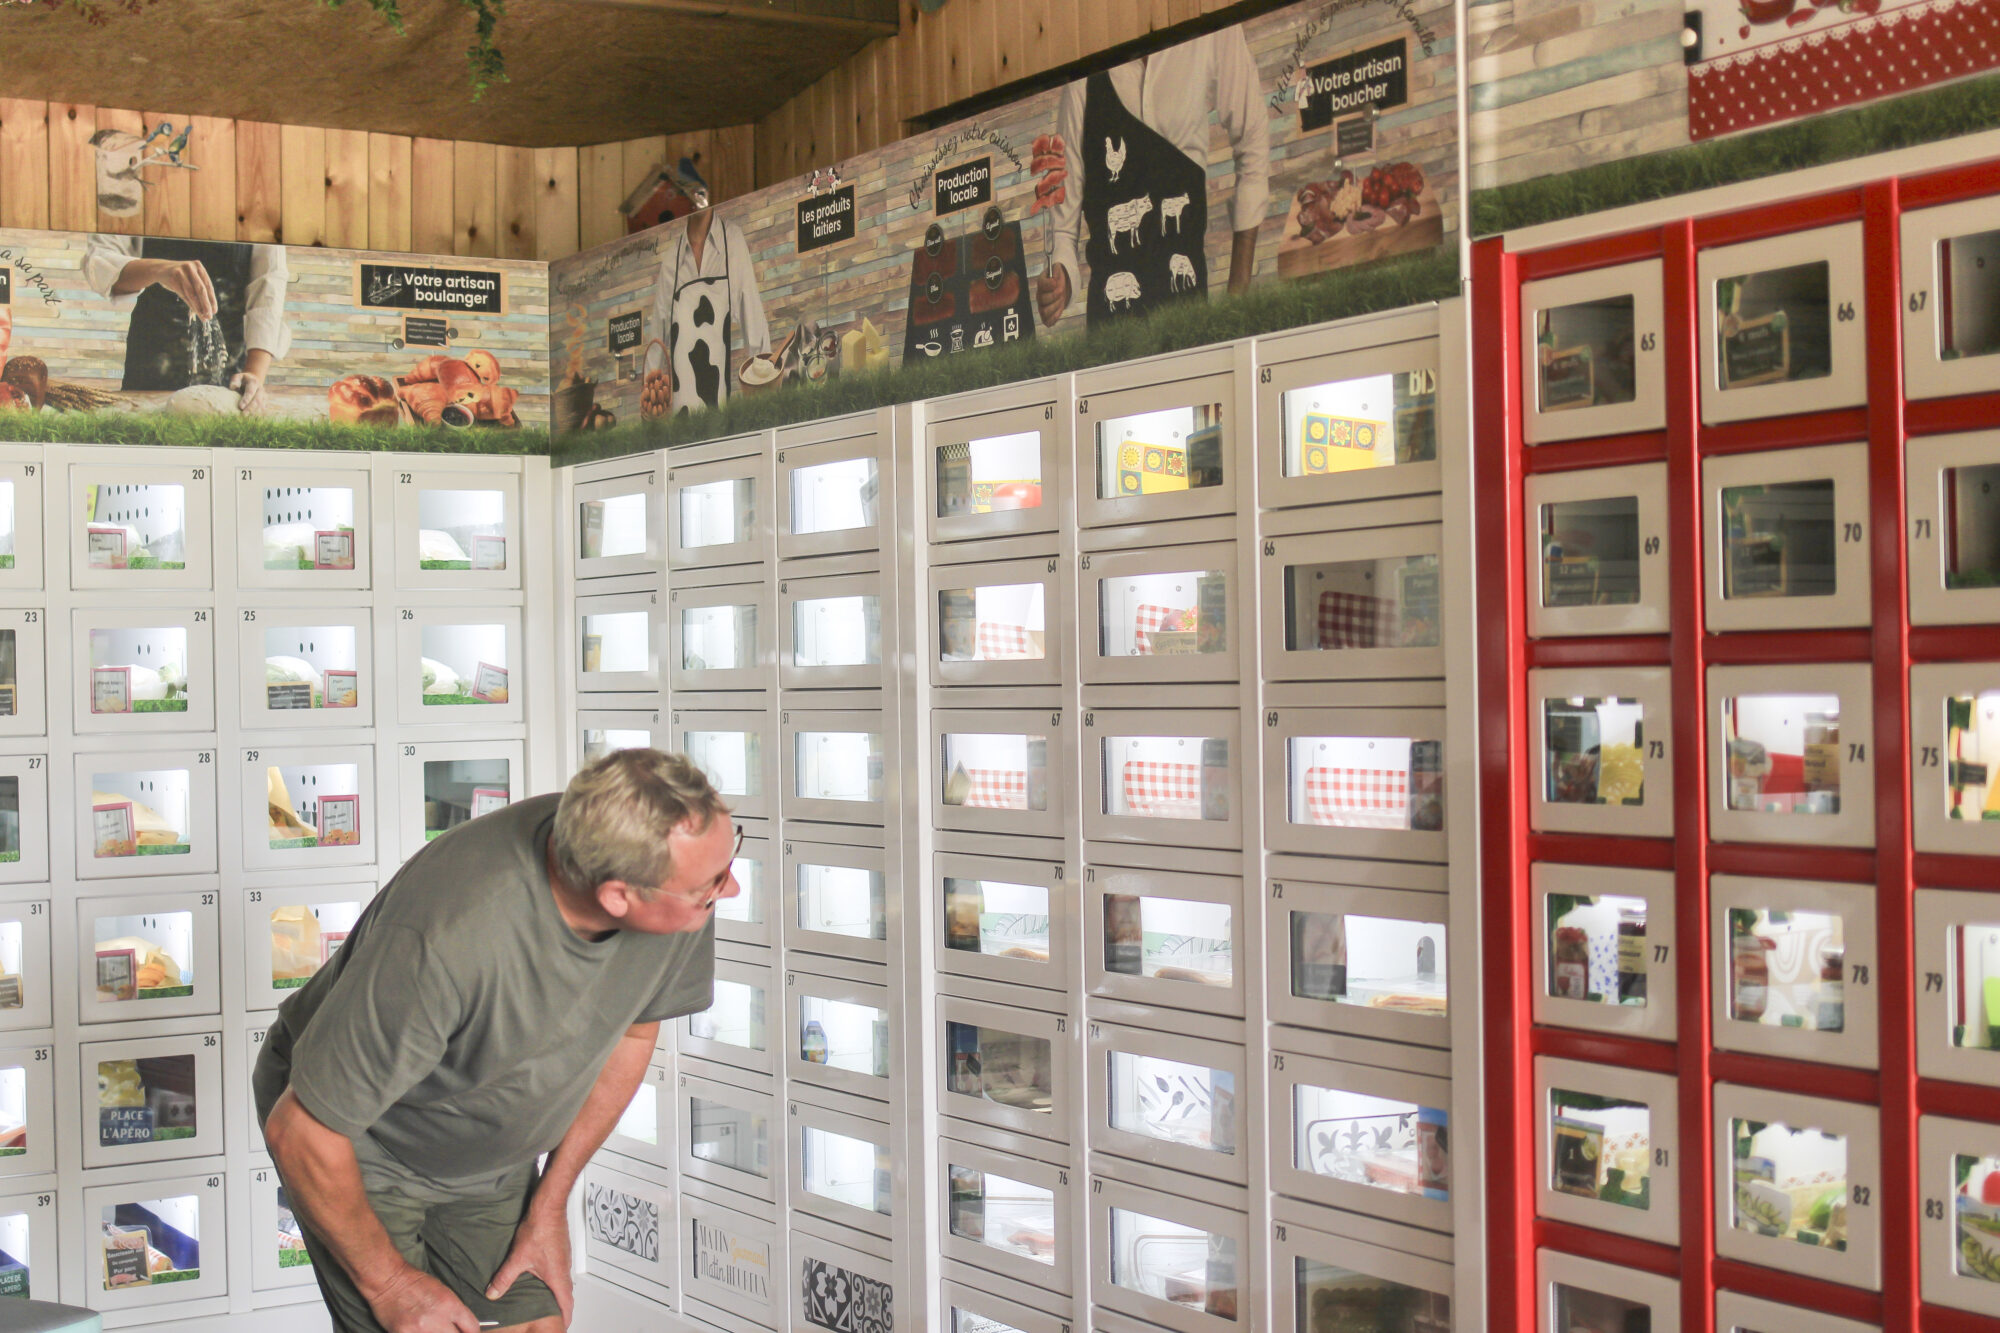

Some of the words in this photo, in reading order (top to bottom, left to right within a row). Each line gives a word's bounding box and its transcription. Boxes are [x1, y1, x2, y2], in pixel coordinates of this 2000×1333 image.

[1270, 64, 1294, 114] Petits
[1292, 22, 1317, 68] plats
[1314, 72, 1350, 94] Votre
[1353, 55, 1402, 83] artisan
[1332, 81, 1388, 112] boucher
[960, 122, 987, 144] votre
[990, 132, 1022, 174] cuisson
[938, 167, 988, 192] Production
[950, 185, 978, 204] locale
[801, 208, 814, 224] Les
[816, 197, 851, 222] produits
[813, 218, 842, 239] laitiers
[14, 256, 33, 273] sa
[26, 273, 63, 306] part
[404, 273, 442, 287] Votre
[445, 276, 496, 290] artisan
[415, 288, 488, 308] boulanger
[1908, 292, 1926, 312] 67
[1837, 303, 1855, 321] 66
[610, 317, 641, 334] Production
[617, 332, 635, 344] locale
[1640, 334, 1656, 351] 65
[1261, 368, 1271, 383] 63
[1044, 406, 1053, 420] 61
[1079, 400, 1088, 414] 62
[778, 452, 785, 464] 45
[24, 466, 36, 477] 19
[192, 469, 205, 480] 20
[241, 470, 252, 480] 21
[668, 472, 674, 482] 44
[400, 474, 412, 484] 22
[1844, 523, 1862, 543] 70
[1914, 519, 1931, 540] 71
[1264, 542, 1275, 556] 66
[1644, 537, 1660, 555] 69
[1047, 560, 1056, 572] 64
[1081, 556, 1090, 570] 65
[780, 584, 788, 594] 48
[672, 592, 678, 602] 47
[24, 612, 38, 622] 23
[194, 612, 206, 622] 24
[244, 610, 256, 622] 25
[402, 610, 414, 620] 26
[674, 714, 680, 724] 50
[783, 713, 789, 724] 51
[1052, 714, 1060, 726] 67
[1084, 714, 1094, 727] 68
[1267, 712, 1278, 727] 69
[246, 750, 259, 762] 29
[404, 746, 416, 756] 30
[1649, 741, 1664, 760] 73
[1848, 744, 1865, 762] 74
[29, 758, 42, 769] 27
[198, 753, 211, 764] 28
[1921, 747, 1939, 768] 75
[785, 844, 792, 855] 54
[1054, 866, 1063, 880] 70
[1087, 869, 1096, 882] 71
[250, 891, 262, 902] 33
[1272, 884, 1282, 898] 72
[202, 895, 214, 905] 32
[30, 904, 42, 914] 31
[1653, 946, 1668, 964] 77
[788, 974, 794, 986] 57
[1852, 966, 1869, 985] 78
[1925, 972, 1943, 993] 79
[1056, 1019, 1066, 1032] 73
[1090, 1024, 1100, 1038] 74
[204, 1036, 216, 1047] 36
[253, 1032, 265, 1042] 37
[34, 1050, 48, 1061] 35
[1274, 1055, 1284, 1071] 75
[658, 1070, 664, 1082] 58
[680, 1076, 686, 1088] 59
[110, 1110, 144, 1121] PLACE
[790, 1104, 798, 1116] 60
[102, 1125, 150, 1139] L'APÉRO
[1656, 1148, 1668, 1167] 81
[206, 1177, 220, 1188] 40
[256, 1172, 268, 1183] 41
[1058, 1172, 1068, 1184] 76
[1093, 1181, 1102, 1194] 77
[38, 1195, 50, 1206] 39
[1853, 1186, 1870, 1206] 82
[1926, 1200, 1944, 1220] 83
[1276, 1226, 1286, 1242] 78
[701, 1250, 726, 1282] Matin
